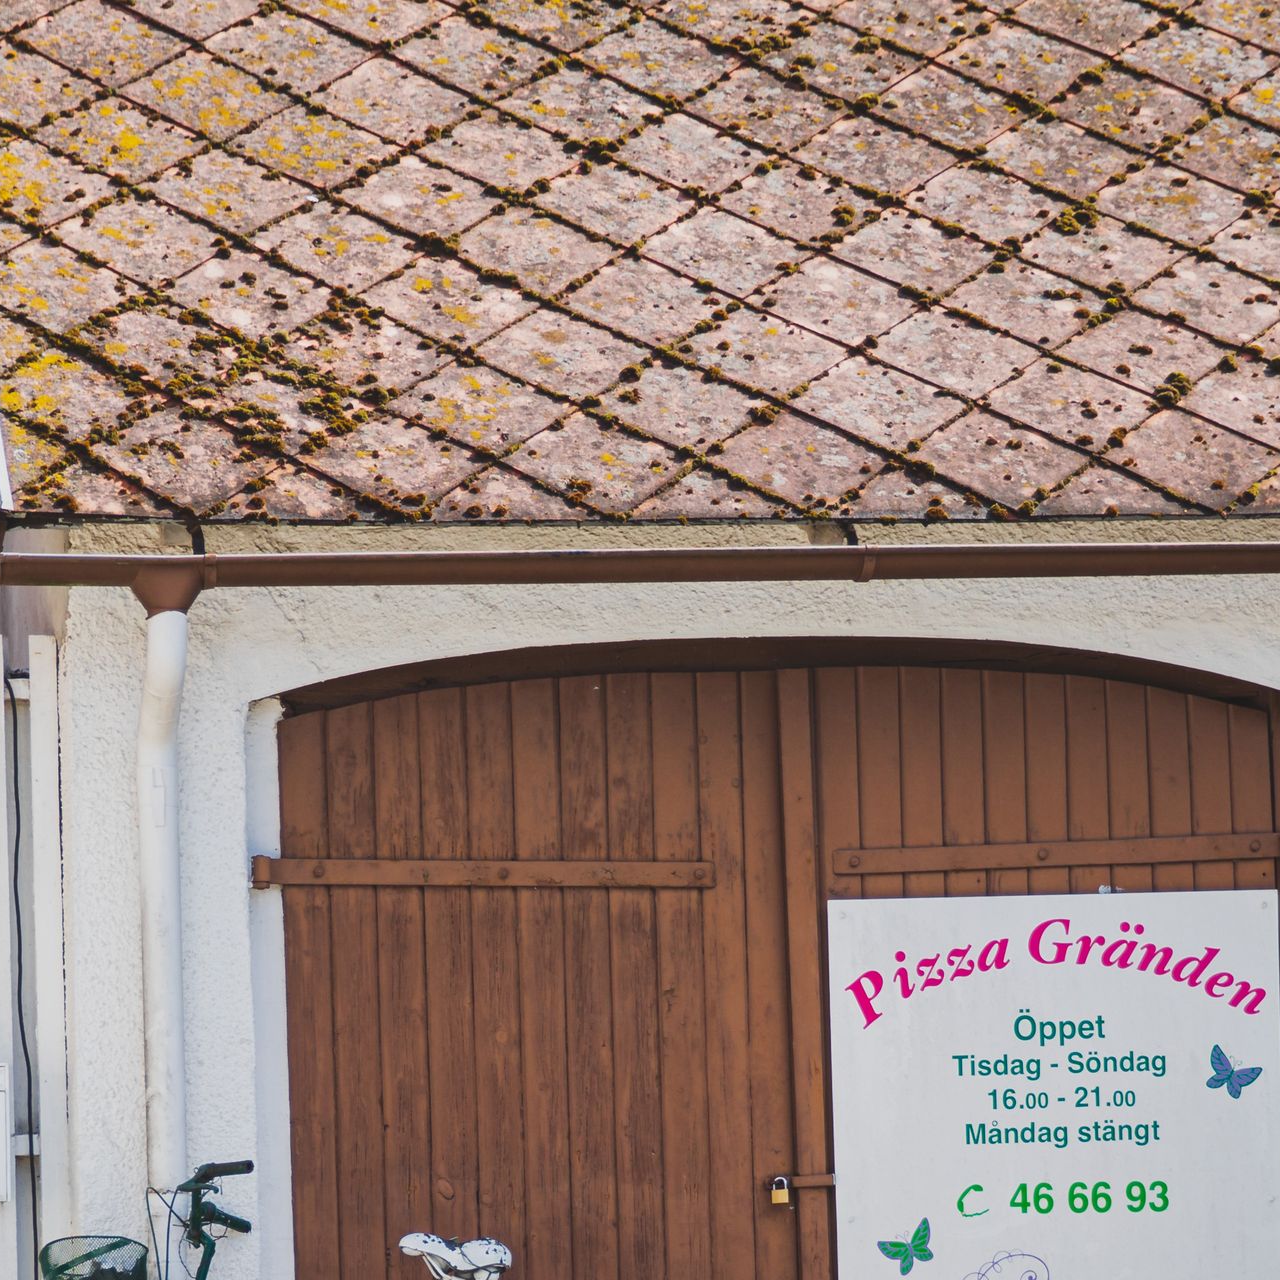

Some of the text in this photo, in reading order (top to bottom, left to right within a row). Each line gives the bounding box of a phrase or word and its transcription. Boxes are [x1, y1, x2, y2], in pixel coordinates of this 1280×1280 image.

[844, 918, 1268, 1030] Pizza Gränden
[1012, 1008, 1106, 1047] Öppet
[951, 1053, 1042, 1081] Tisdag
[1066, 1050, 1168, 1078] Söndag
[987, 1088, 1050, 1111] 16.00
[1073, 1086, 1137, 1109] 21.00
[964, 1118, 1161, 1149] Måndag stängt
[1008, 1180, 1170, 1215] 46 66 93
